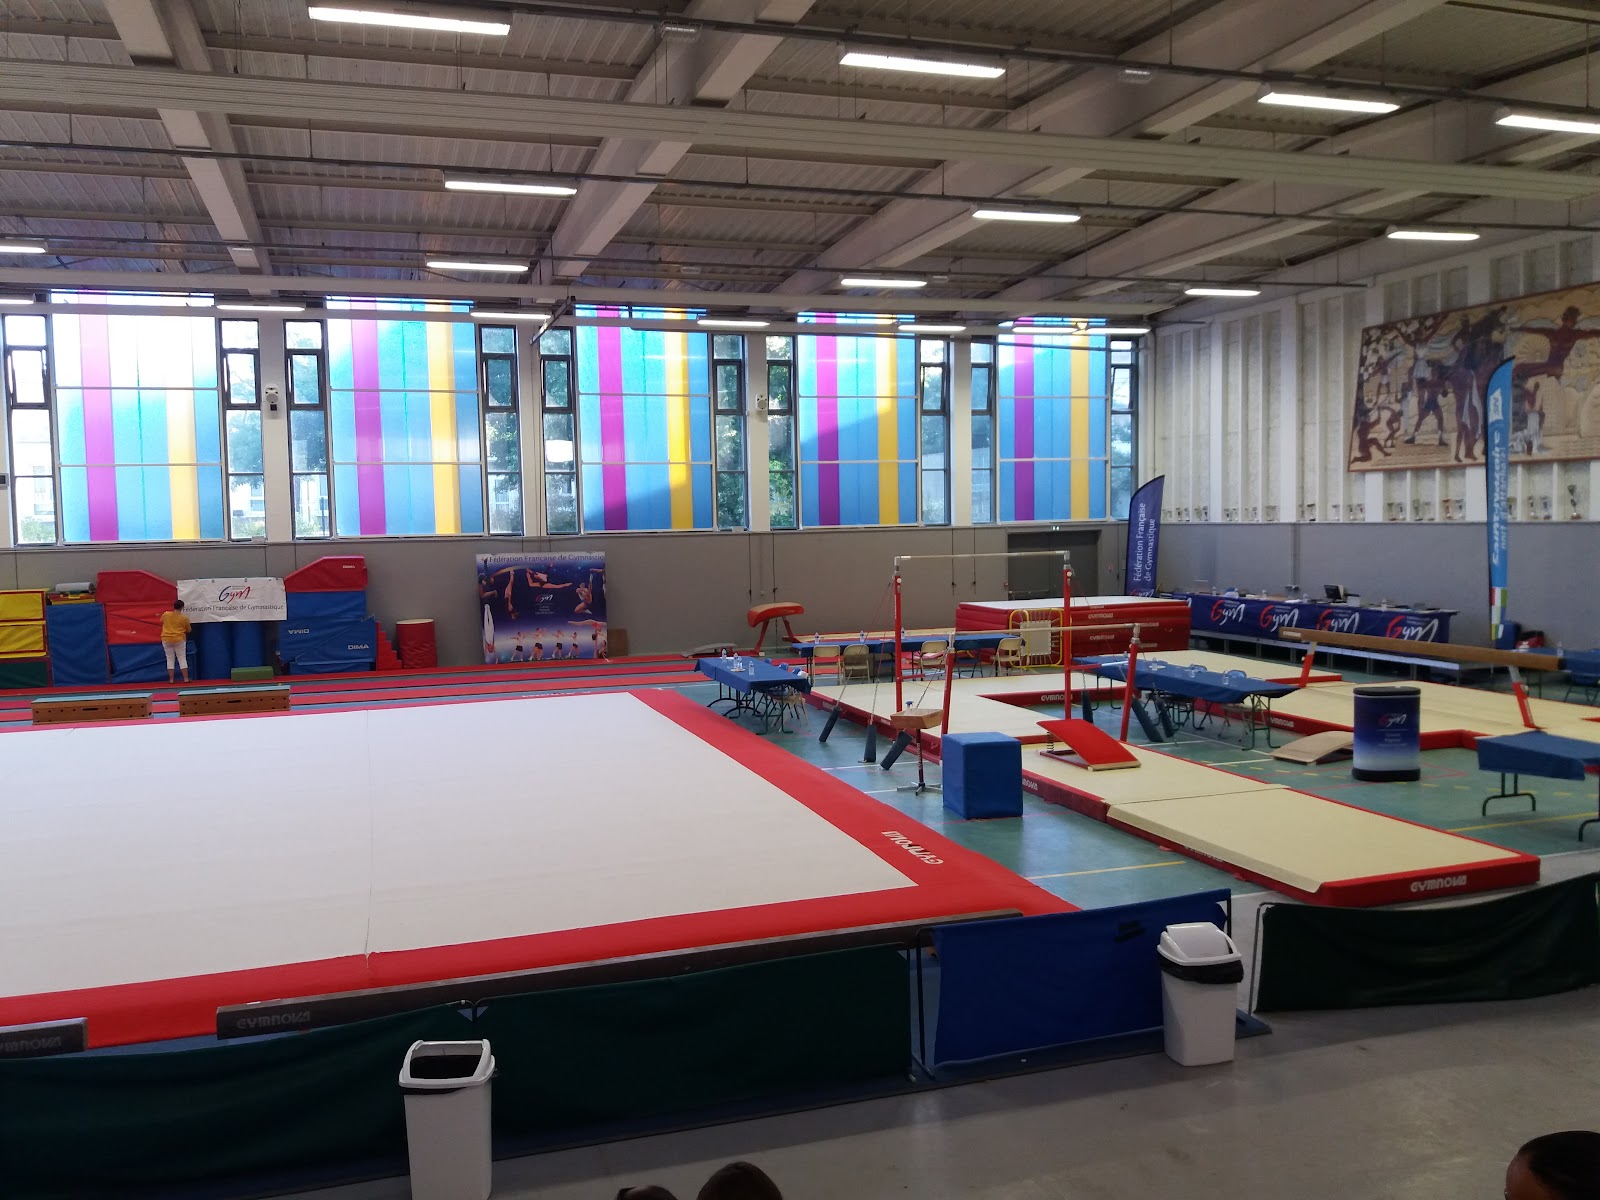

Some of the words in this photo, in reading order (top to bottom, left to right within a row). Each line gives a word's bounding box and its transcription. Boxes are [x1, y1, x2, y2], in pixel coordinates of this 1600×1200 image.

[1136, 502, 1146, 539] Française
[1145, 518, 1157, 571] Gymnastique
[489, 555, 522, 563] Fédération
[524, 554, 558, 562] Française
[1133, 540, 1144, 581] Fédération
[1144, 571, 1152, 582] de
[182, 605, 212, 613] Fédération
[881, 831, 944, 864] GYMNOVA
[1410, 875, 1467, 892] GYMNOVA
[236, 1010, 311, 1029] GYMNOVA
